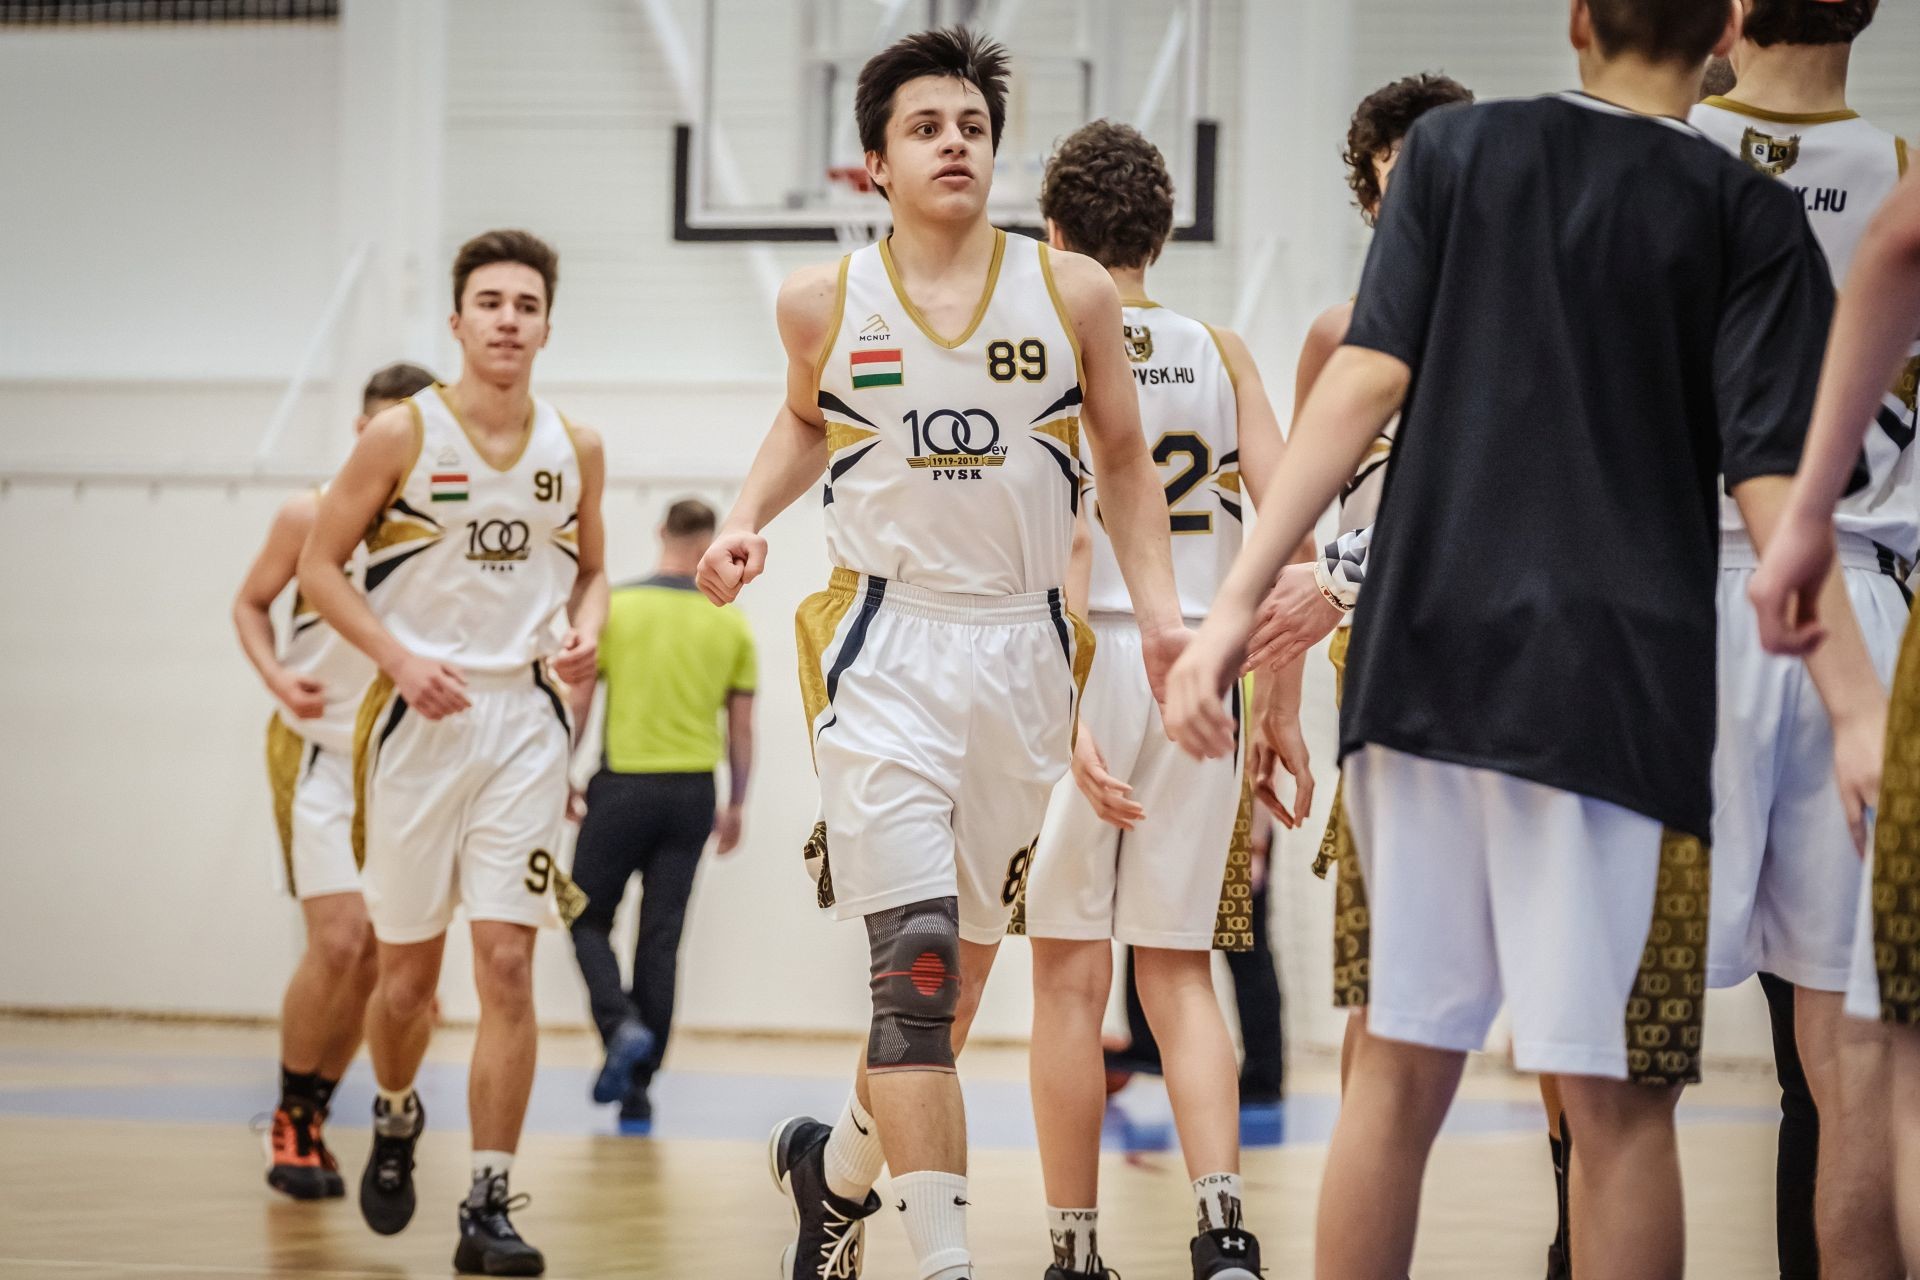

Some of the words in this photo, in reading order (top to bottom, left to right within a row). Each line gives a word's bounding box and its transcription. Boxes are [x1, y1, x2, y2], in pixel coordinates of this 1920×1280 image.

[859, 334, 891, 342] MCNUT
[986, 337, 1048, 383] 89
[1132, 367, 1195, 385] VSK.HU
[902, 408, 1000, 456] 100
[932, 456, 979, 466] 1919-2019
[534, 470, 562, 502] 91
[932, 469, 982, 481] PVSK
[466, 519, 530, 553] 100
